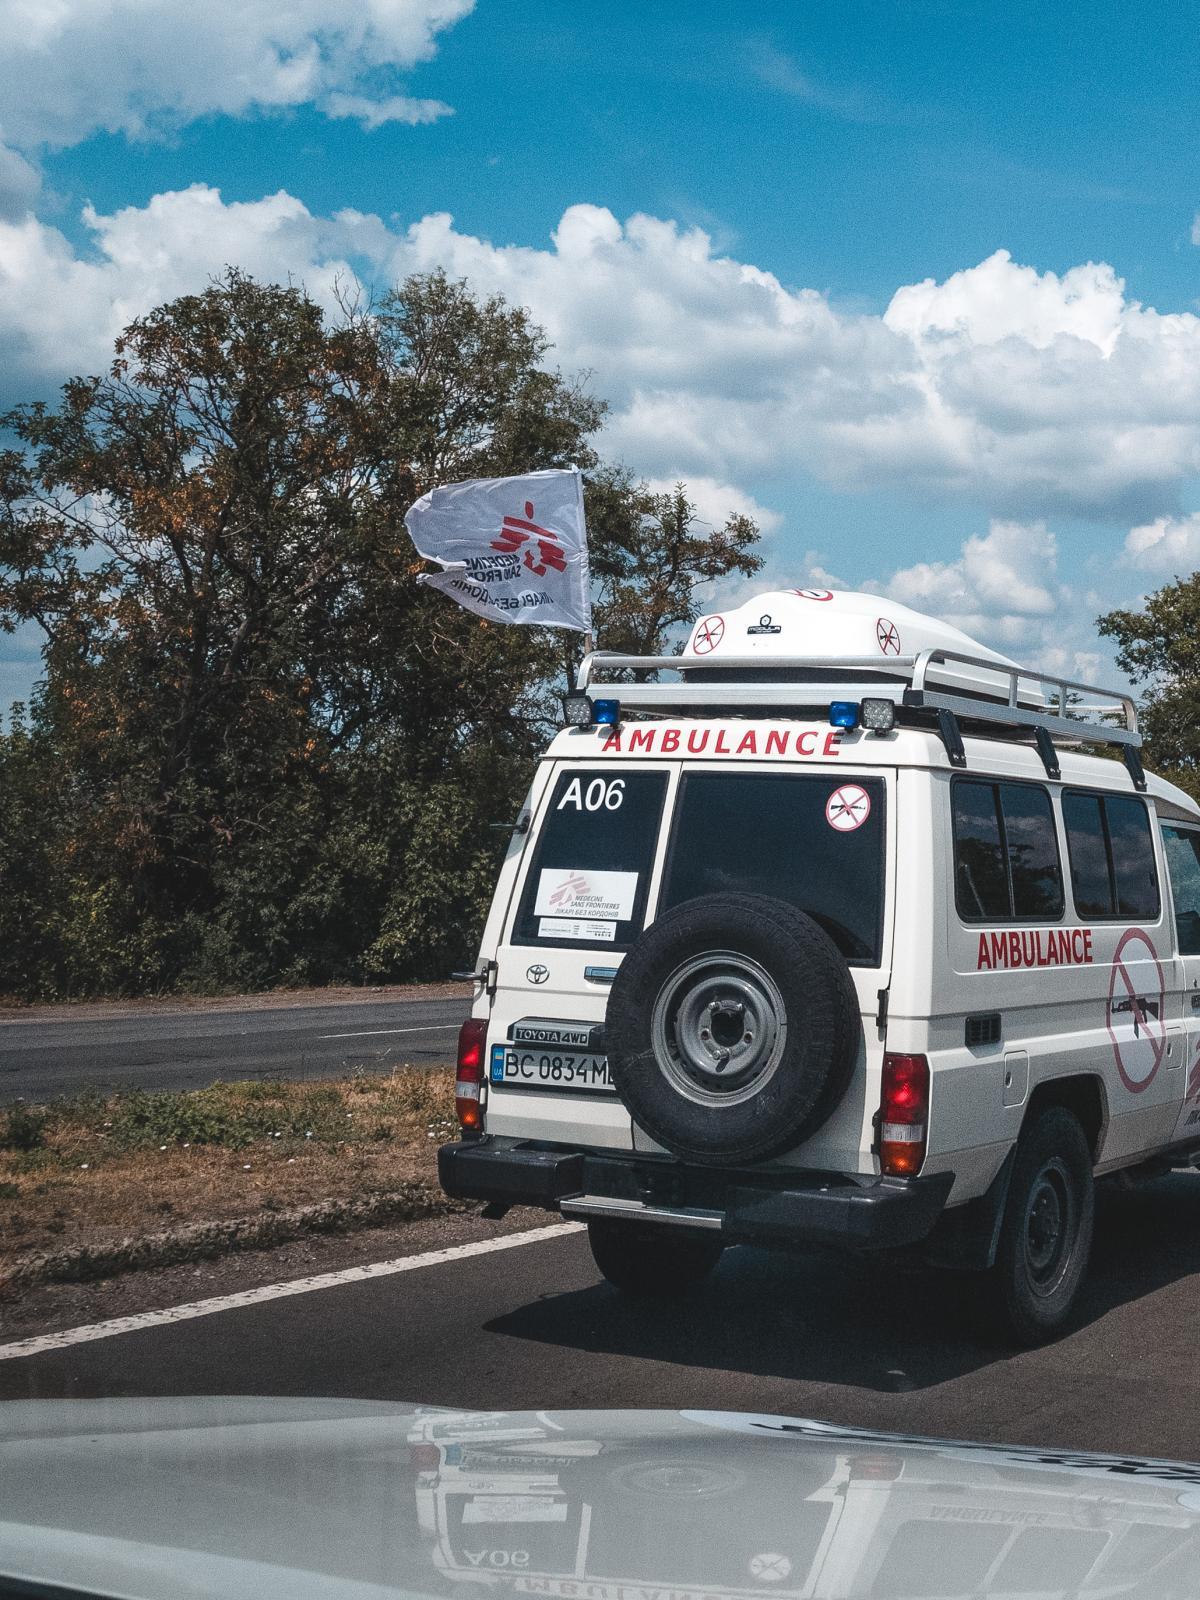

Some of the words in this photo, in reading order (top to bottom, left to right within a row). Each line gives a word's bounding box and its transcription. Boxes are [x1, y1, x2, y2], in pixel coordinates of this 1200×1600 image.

[602, 729, 843, 756] AMBULANCE
[557, 778, 626, 811] A06
[585, 902, 621, 910] FRONTIERES
[977, 929, 1093, 970] AMBULANCE
[518, 1029, 558, 1041] TOYOTA
[561, 1033, 588, 1043] 4WD
[493, 1068, 503, 1076] UA
[538, 1055, 588, 1084] 0834
